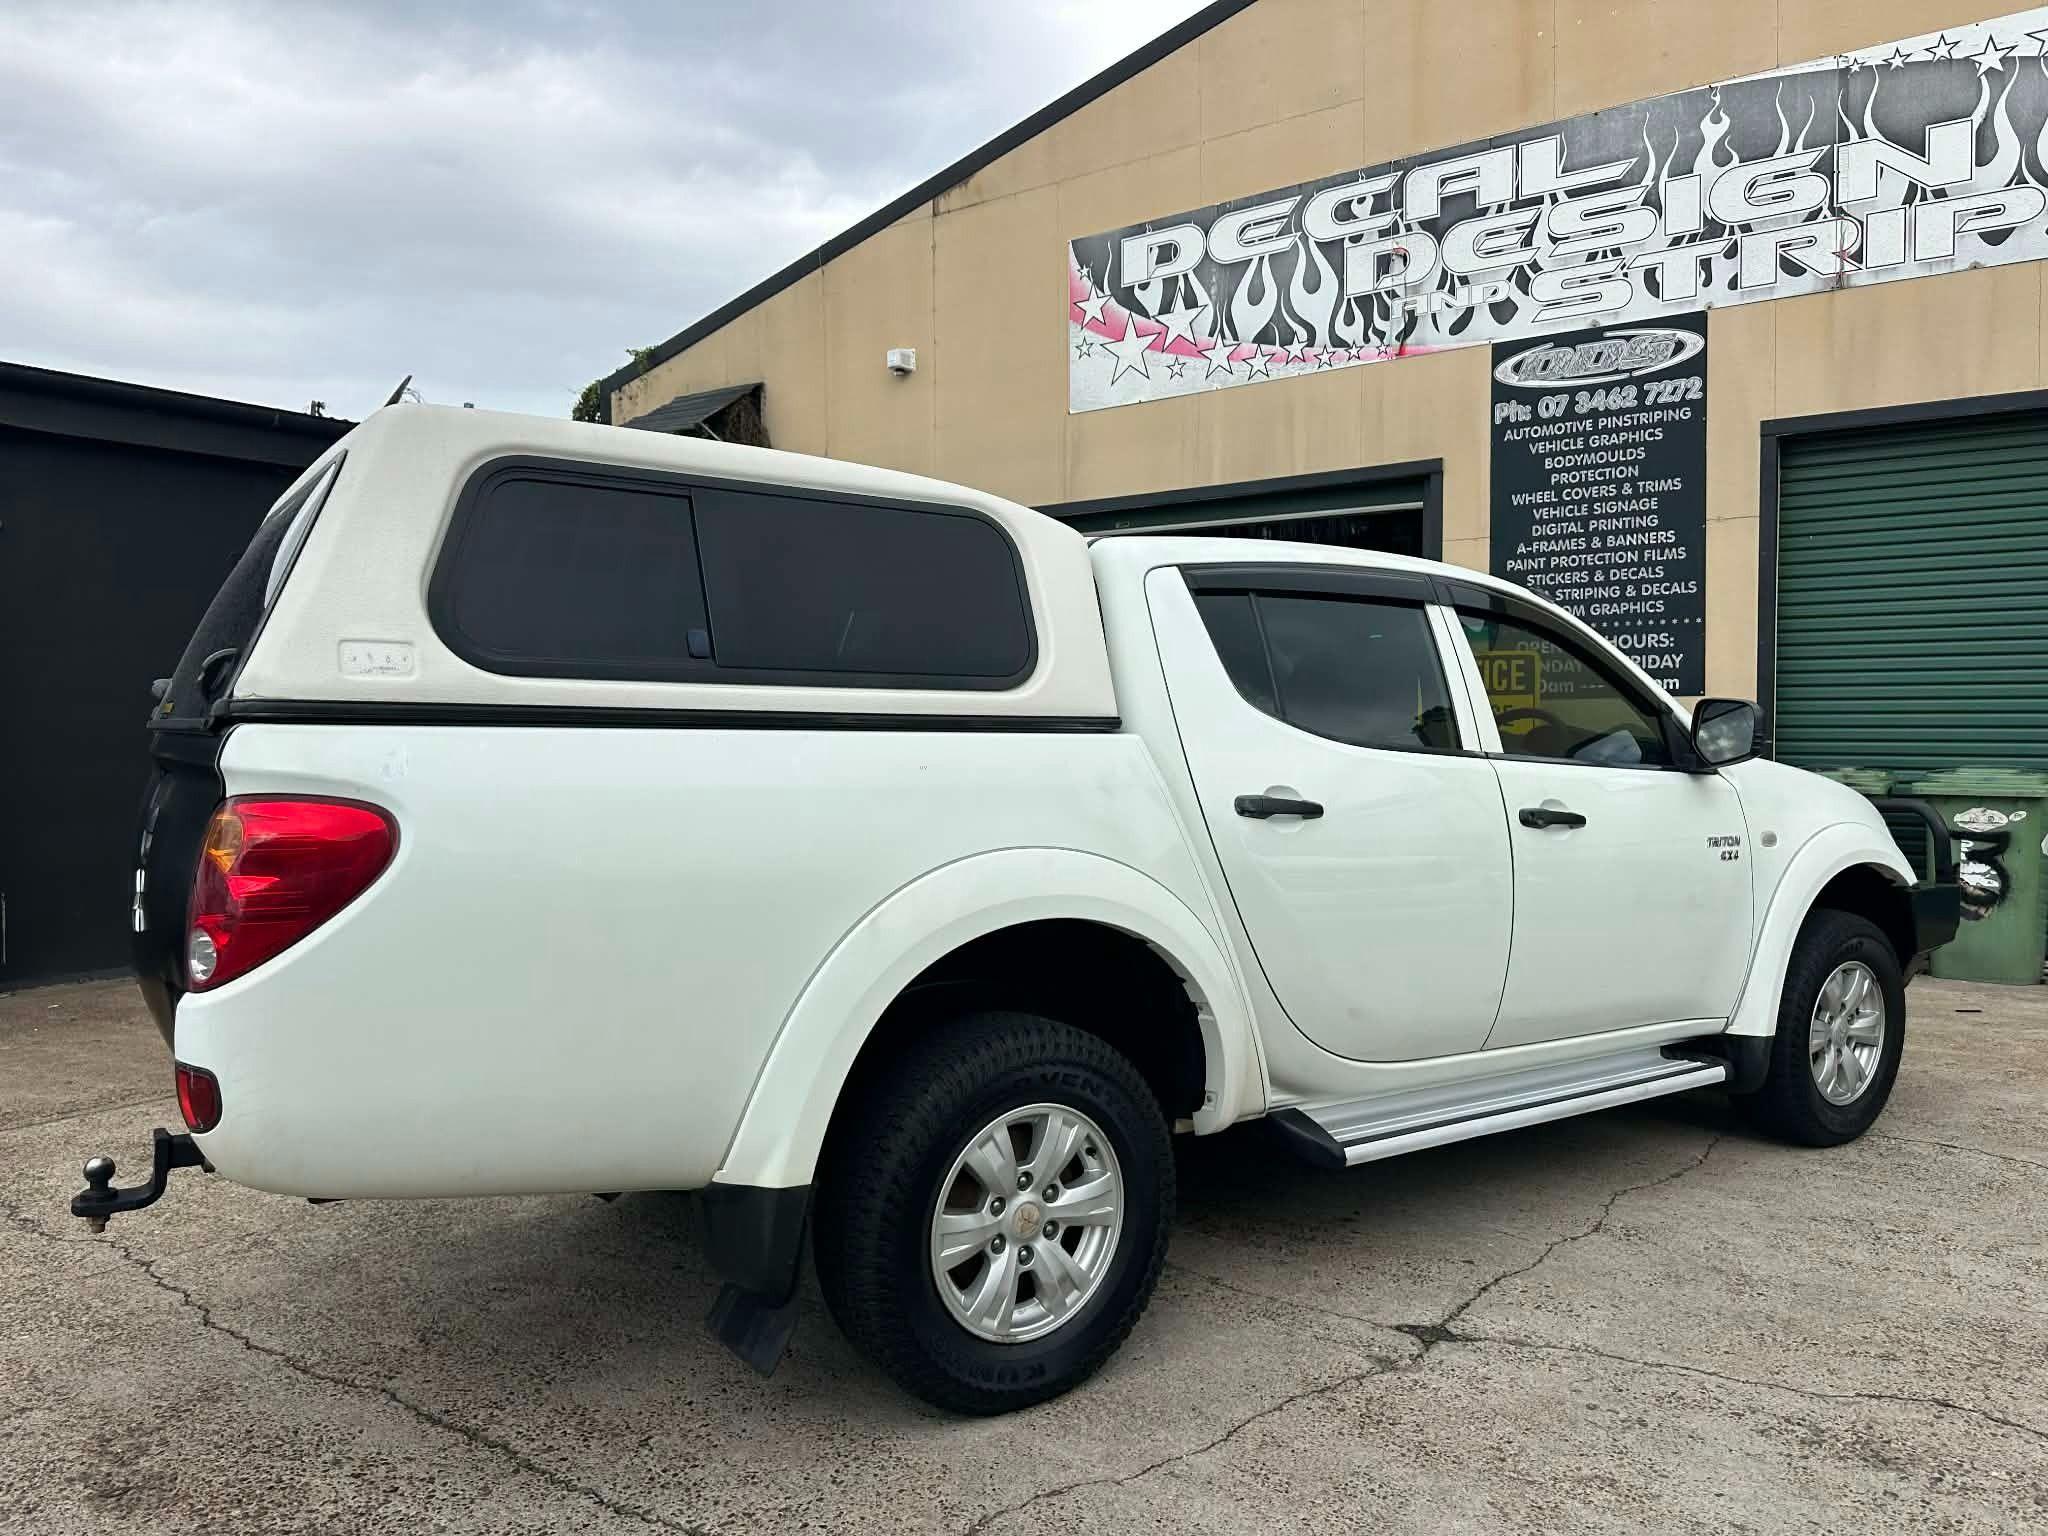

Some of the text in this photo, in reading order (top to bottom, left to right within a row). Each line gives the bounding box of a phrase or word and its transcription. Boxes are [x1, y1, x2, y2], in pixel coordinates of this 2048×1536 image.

[1121, 133, 1640, 287] DECAL
[1344, 118, 1976, 298] DESIGN
[1389, 279, 1511, 320] AND
[1494, 376, 1703, 424] Ph: 07 3462 7272
[1504, 407, 1692, 441] AUTOMOTIVE PINSTRIPING
[1529, 428, 1664, 455] VEHICLE GRAPHICS
[1544, 447, 1646, 469] BODYMOULDS
[1551, 465, 1639, 485] PROTECTION
[1511, 477, 1682, 506] WHEEL COVERS & TRIMS
[1533, 498, 1658, 520] VEHICLE SIGNAGE
[1532, 515, 1659, 537] DIGITAL PRINTING
[1516, 530, 1676, 555] A-FRAMES & BANNERS
[1506, 547, 1687, 572] PAINT PROTECTION FILMS
[1526, 566, 1664, 587] STICKERS & DECALS
[1555, 584, 1621, 602] STRIPING
[1625, 584, 1636, 597] &
[1641, 580, 1697, 596] DECALS
[1590, 600, 1664, 616] GRAPHICS
[1706, 835, 1740, 848] TRITON
